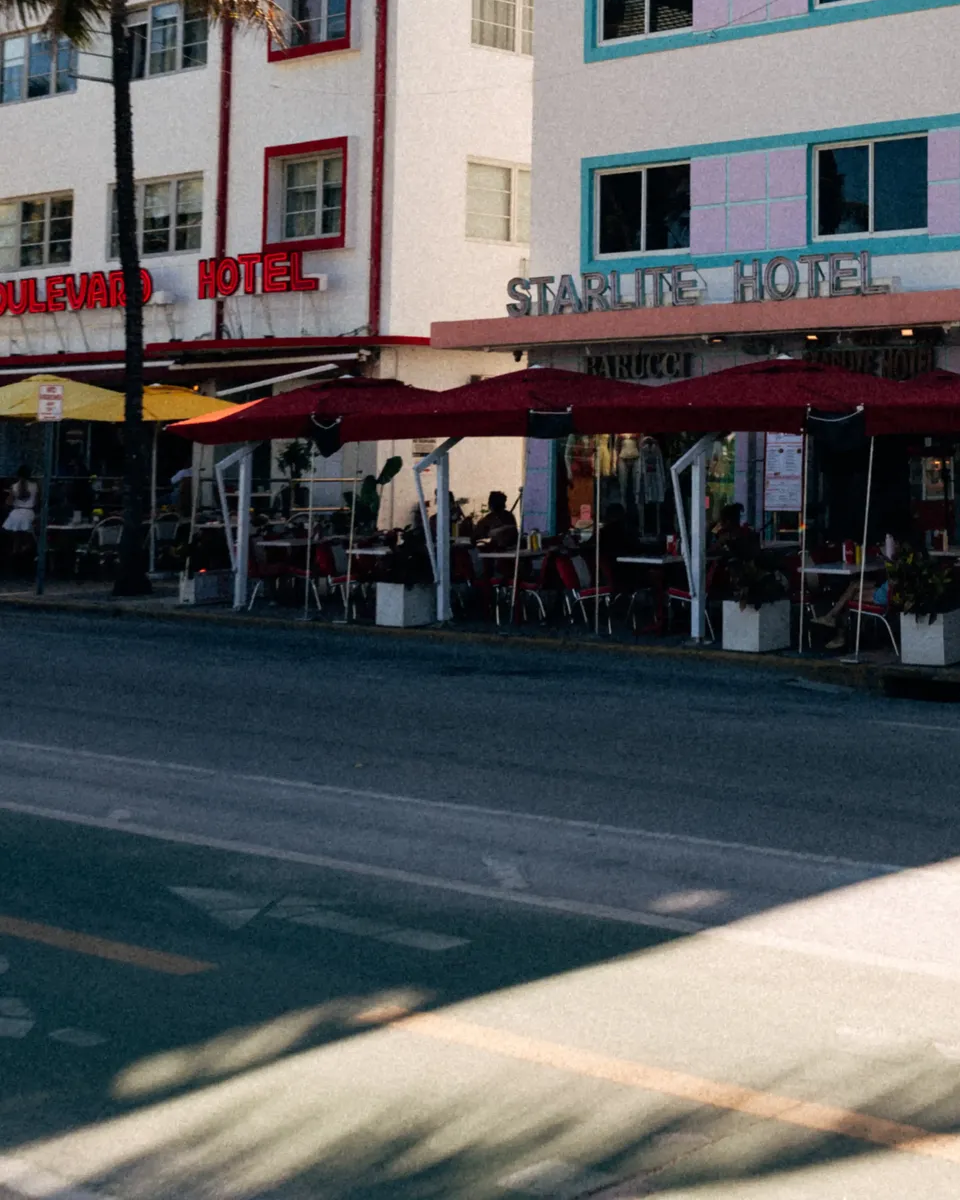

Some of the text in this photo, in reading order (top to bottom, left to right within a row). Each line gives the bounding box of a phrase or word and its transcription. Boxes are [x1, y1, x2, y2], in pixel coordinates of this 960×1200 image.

[198, 251, 319, 299] HOTEL
[506, 250, 890, 317] STARLITE HOTEL
